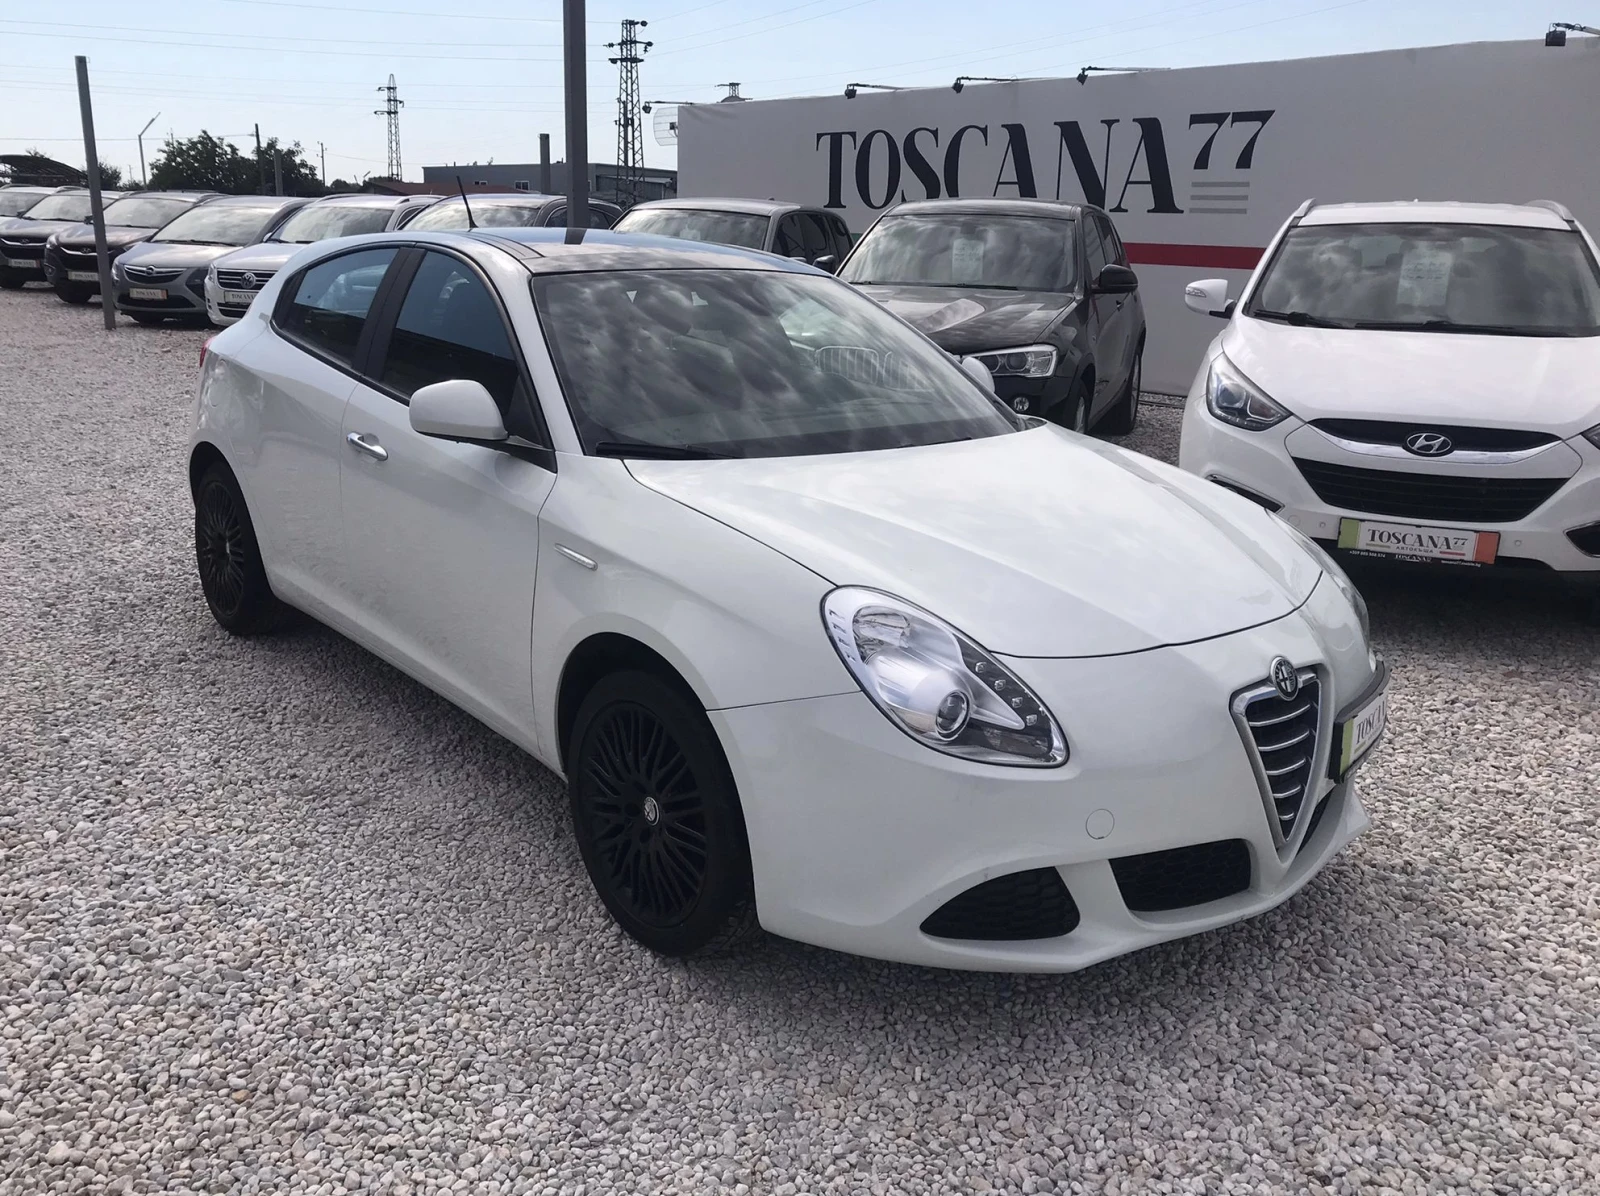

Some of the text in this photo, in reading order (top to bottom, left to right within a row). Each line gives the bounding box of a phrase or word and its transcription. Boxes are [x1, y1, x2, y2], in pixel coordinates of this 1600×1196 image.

[816, 110, 1275, 214] TOSCANA 77
[1368, 528, 1453, 550] TOSCANA
